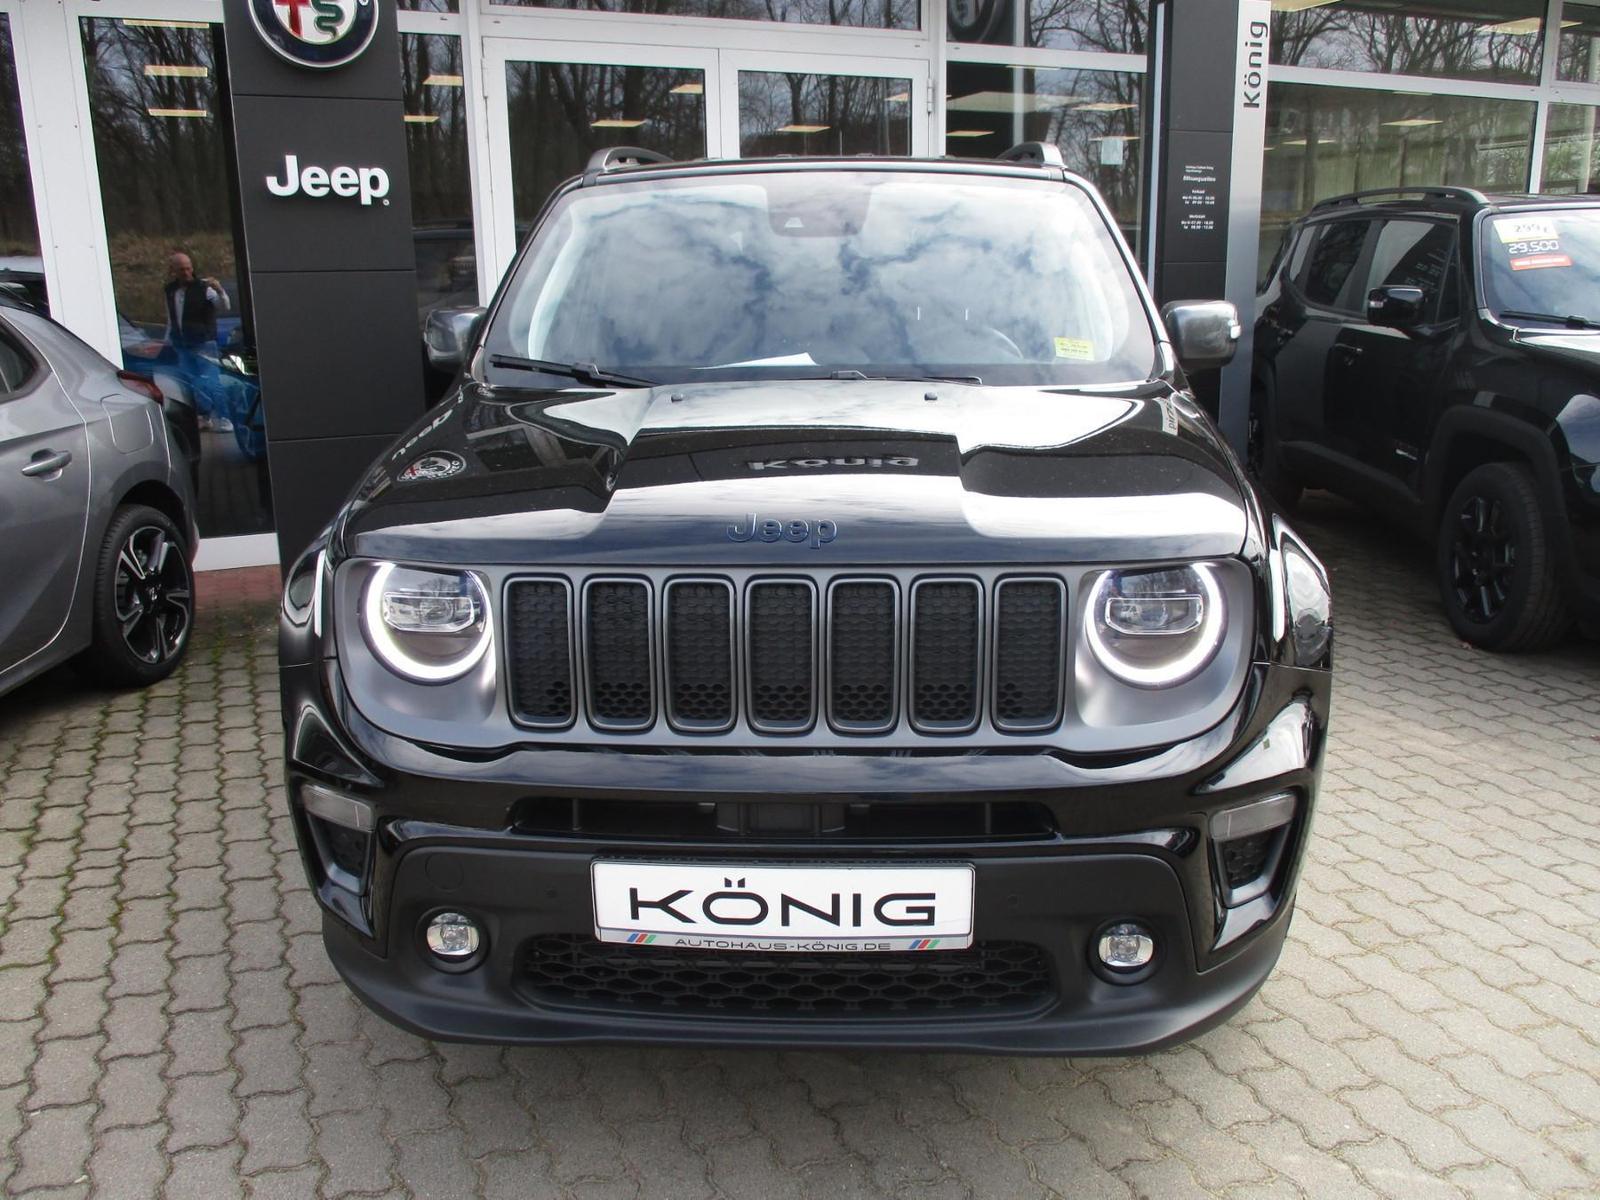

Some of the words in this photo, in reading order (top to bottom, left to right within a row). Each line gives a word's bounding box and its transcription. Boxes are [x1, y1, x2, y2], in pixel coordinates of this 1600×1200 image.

[1243, 21, 1268, 108] König
[266, 155, 389, 206] Jeep
[1508, 240, 1560, 254] 29.500
[727, 513, 838, 549] Jeep
[629, 877, 936, 927] KÖNIG
[675, 938, 891, 951] AUTOHAUS-KÖNIG.DE
